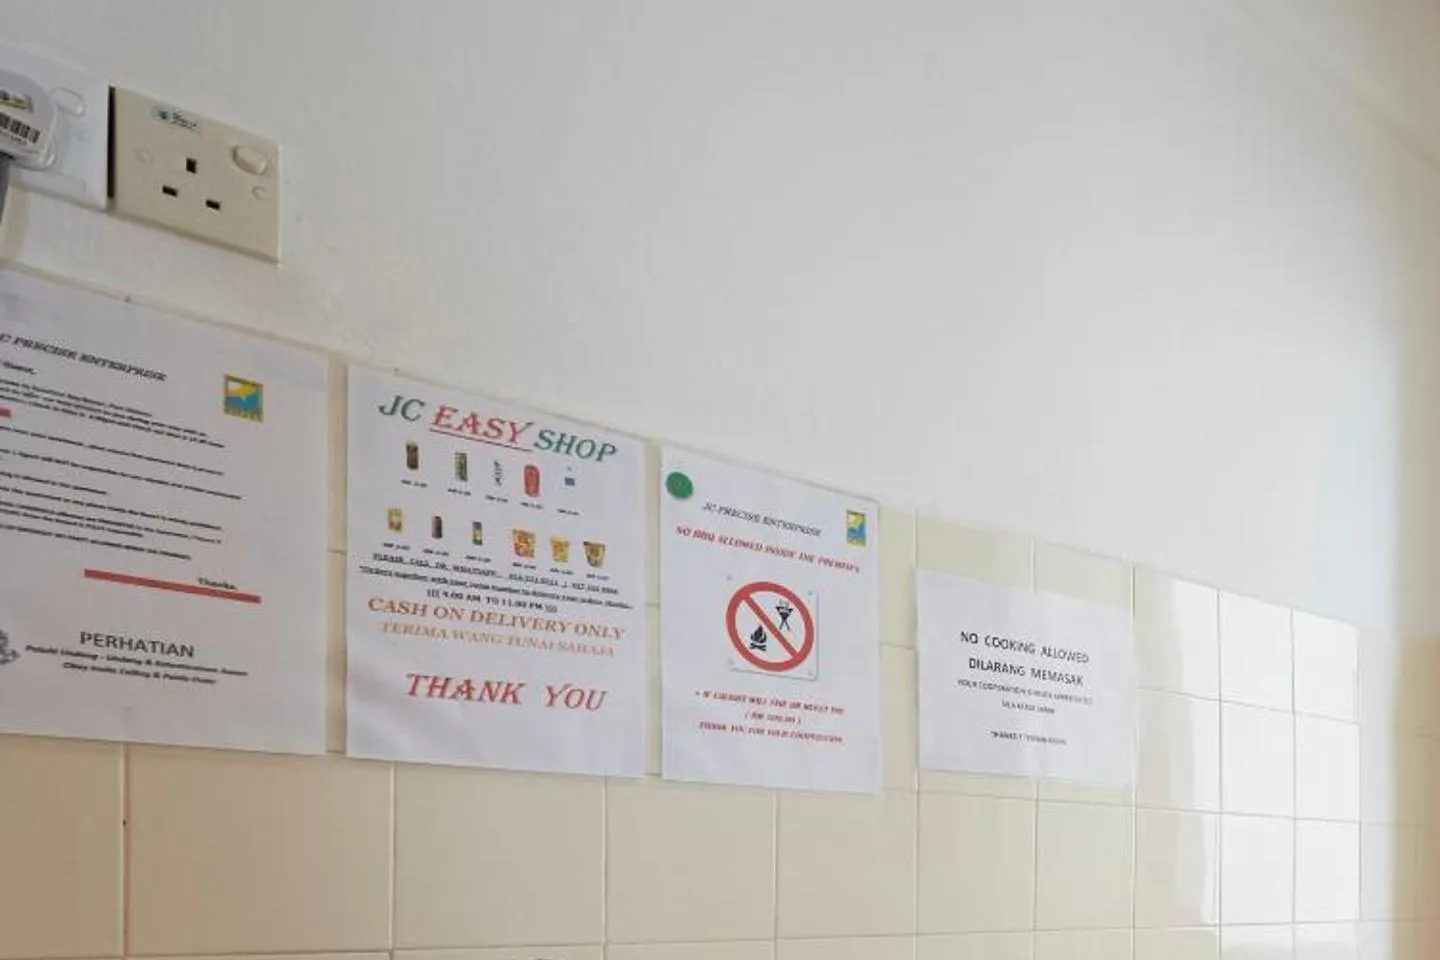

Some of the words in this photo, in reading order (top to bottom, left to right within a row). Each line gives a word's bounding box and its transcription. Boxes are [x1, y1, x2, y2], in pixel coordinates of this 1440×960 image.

[378, 394, 425, 422] JC
[431, 404, 533, 445] EASY
[533, 429, 618, 463] SHOP
[676, 526, 691, 537] NO
[368, 597, 428, 617] CASH
[433, 605, 466, 621] ON
[470, 608, 571, 635] DELIVERY
[574, 622, 626, 641] ONLY
[380, 621, 448, 640] TERIMA
[452, 630, 502, 645] WANG
[79, 631, 195, 658] PERHATIAN
[960, 631, 978, 645] NO
[984, 635, 1035, 655] COOKING
[1040, 646, 1089, 664] ALLOWED
[969, 657, 1026, 677] DILARANG
[1031, 667, 1083, 687] MEMASAK
[406, 673, 526, 705] THANK
[545, 683, 608, 711] YOU
